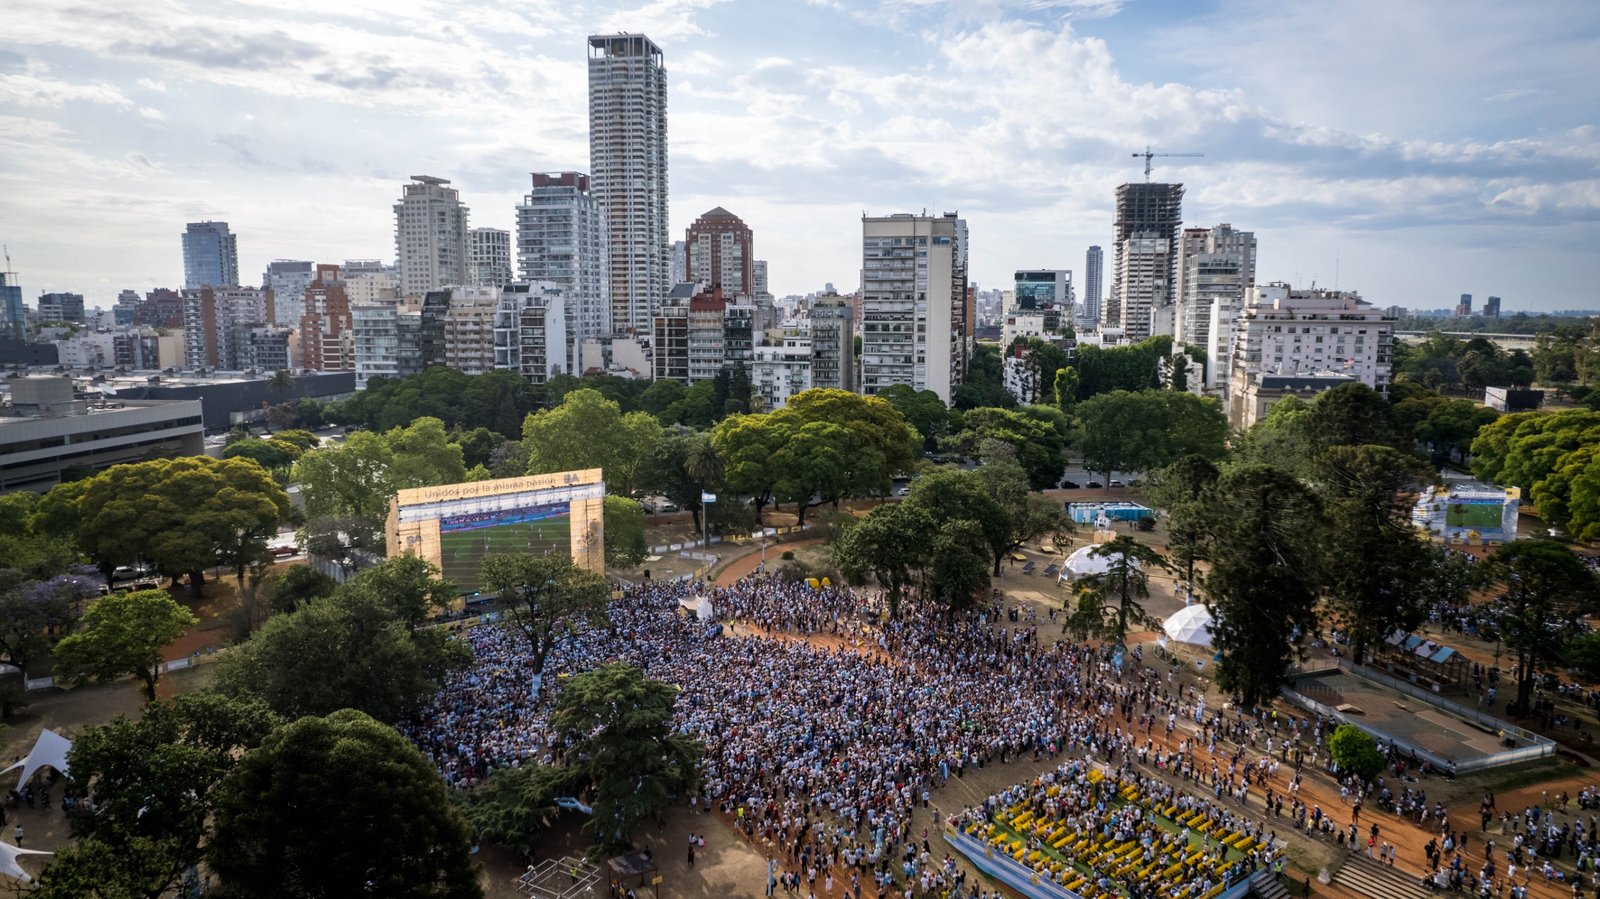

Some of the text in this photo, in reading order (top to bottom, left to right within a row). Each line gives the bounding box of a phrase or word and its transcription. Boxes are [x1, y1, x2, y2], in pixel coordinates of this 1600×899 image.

[563, 473, 580, 483] BA
[425, 487, 459, 498] Unidos
[463, 485, 479, 495] por
[482, 483, 491, 493] la
[494, 481, 524, 491] misma
